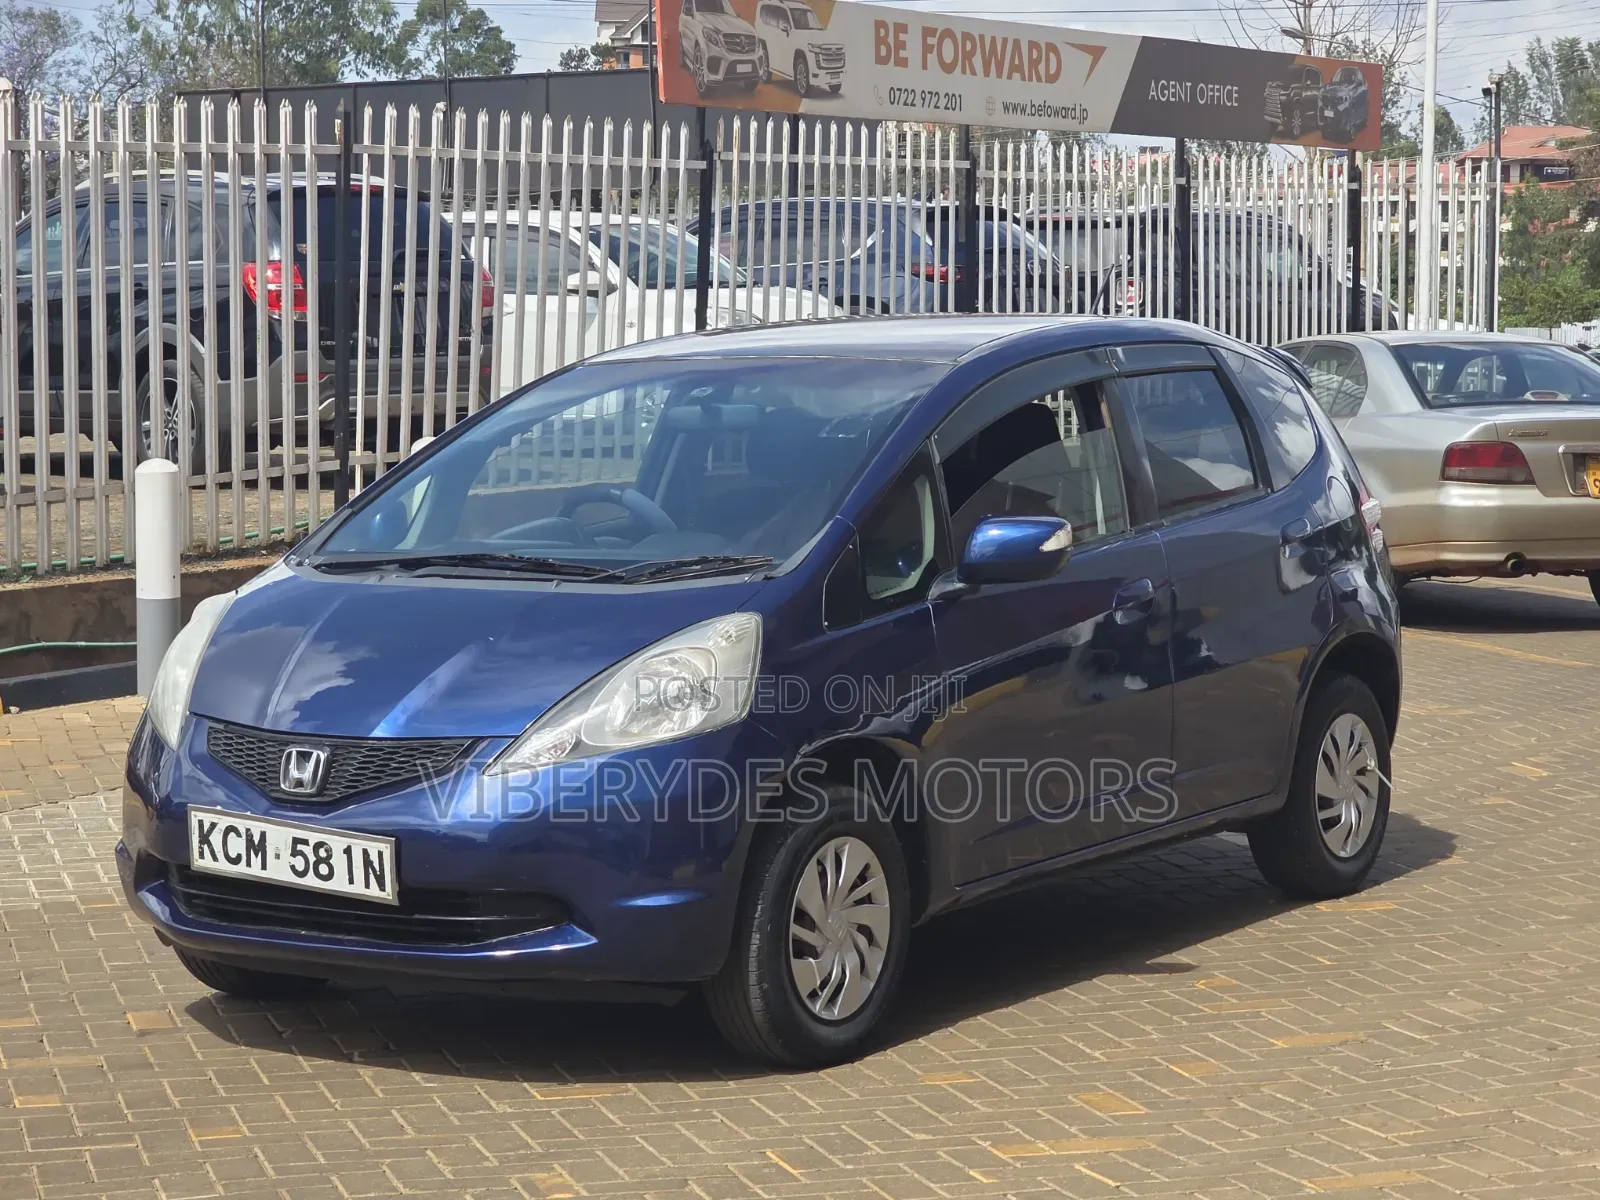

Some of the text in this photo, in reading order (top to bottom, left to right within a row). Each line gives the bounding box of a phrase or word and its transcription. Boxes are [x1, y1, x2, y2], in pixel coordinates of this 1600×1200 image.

[874, 19, 1063, 84] BE FORWARD
[888, 86, 962, 112] 0722 972 201
[1148, 79, 1239, 107] AGENT OFFICE
[1002, 99, 1089, 125] www.befoward.jp
[197, 818, 387, 893] KCM 581N
